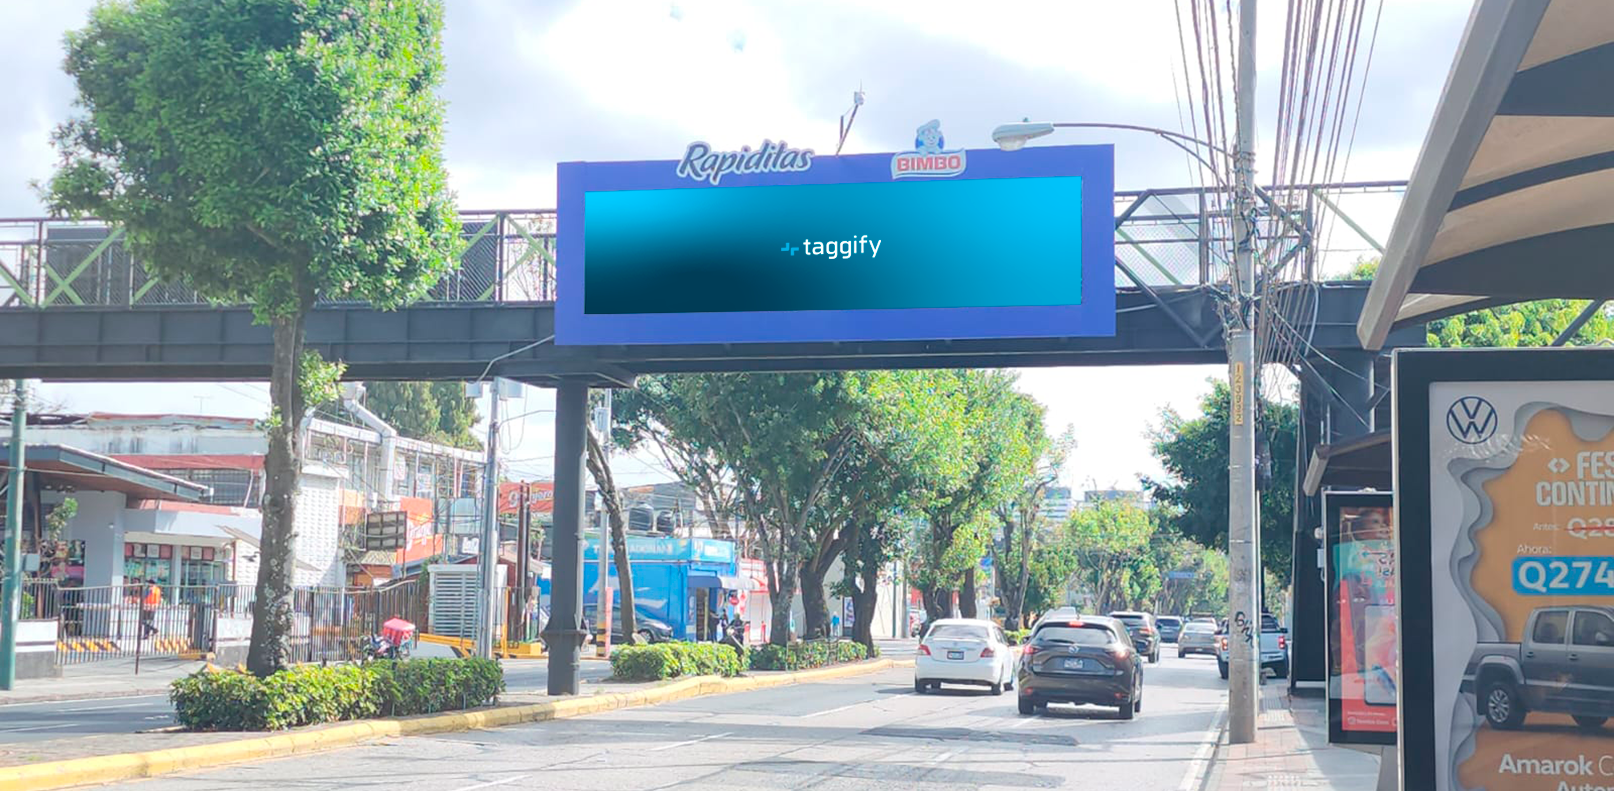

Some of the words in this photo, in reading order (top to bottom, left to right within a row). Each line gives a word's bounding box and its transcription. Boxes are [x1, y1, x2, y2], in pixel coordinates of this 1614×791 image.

[678, 141, 813, 184] Rapiditas
[896, 154, 962, 173] BIMBO
[803, 234, 882, 259] taggify
[1532, 523, 1559, 532] Antes:
[1517, 544, 1552, 554] Ahora:
[1518, 561, 1614, 593] Q274
[1498, 753, 1593, 775] Amarok
